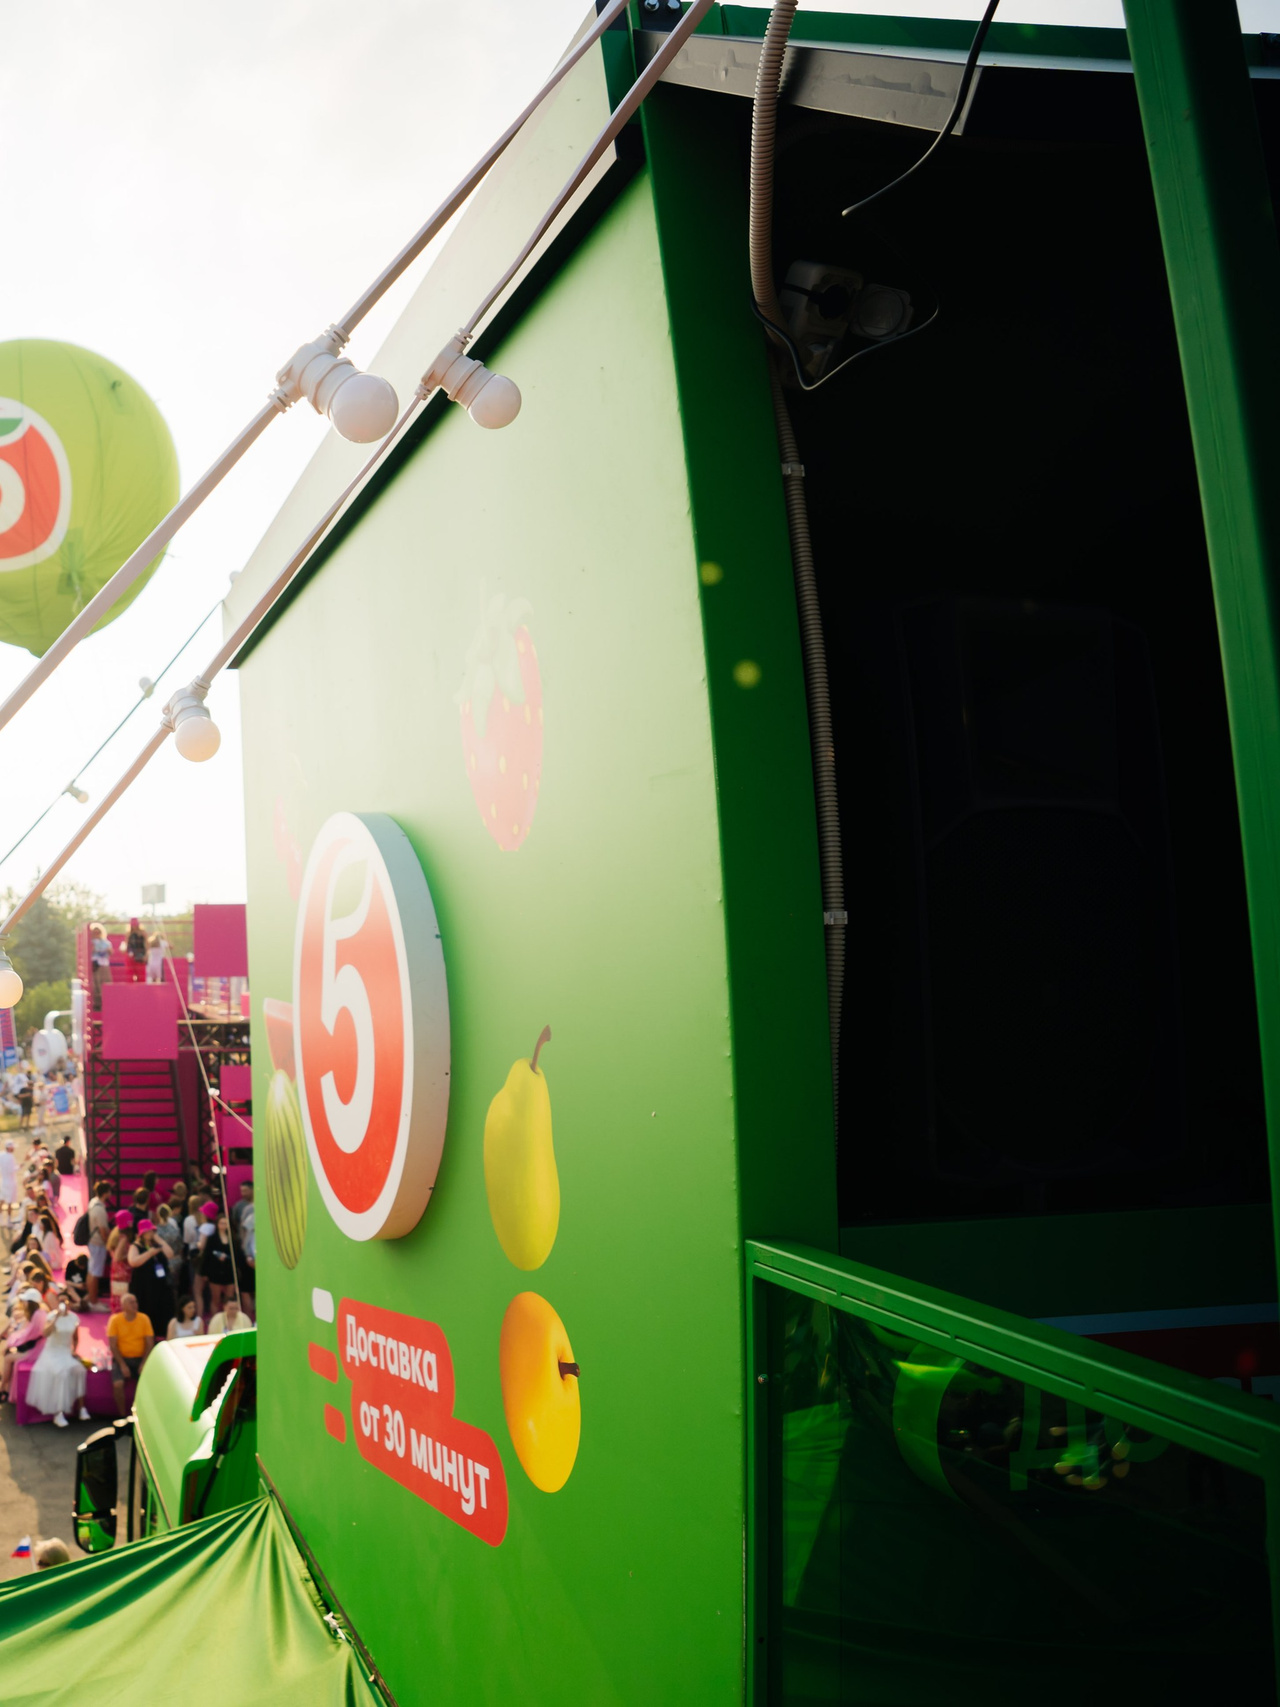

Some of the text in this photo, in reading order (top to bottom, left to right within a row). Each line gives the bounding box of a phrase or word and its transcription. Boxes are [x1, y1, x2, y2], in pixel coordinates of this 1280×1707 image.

[321, 842, 375, 1154] 5
[346, 1315, 439, 1393] Доставка
[359, 1401, 490, 1516] от 30 минут
